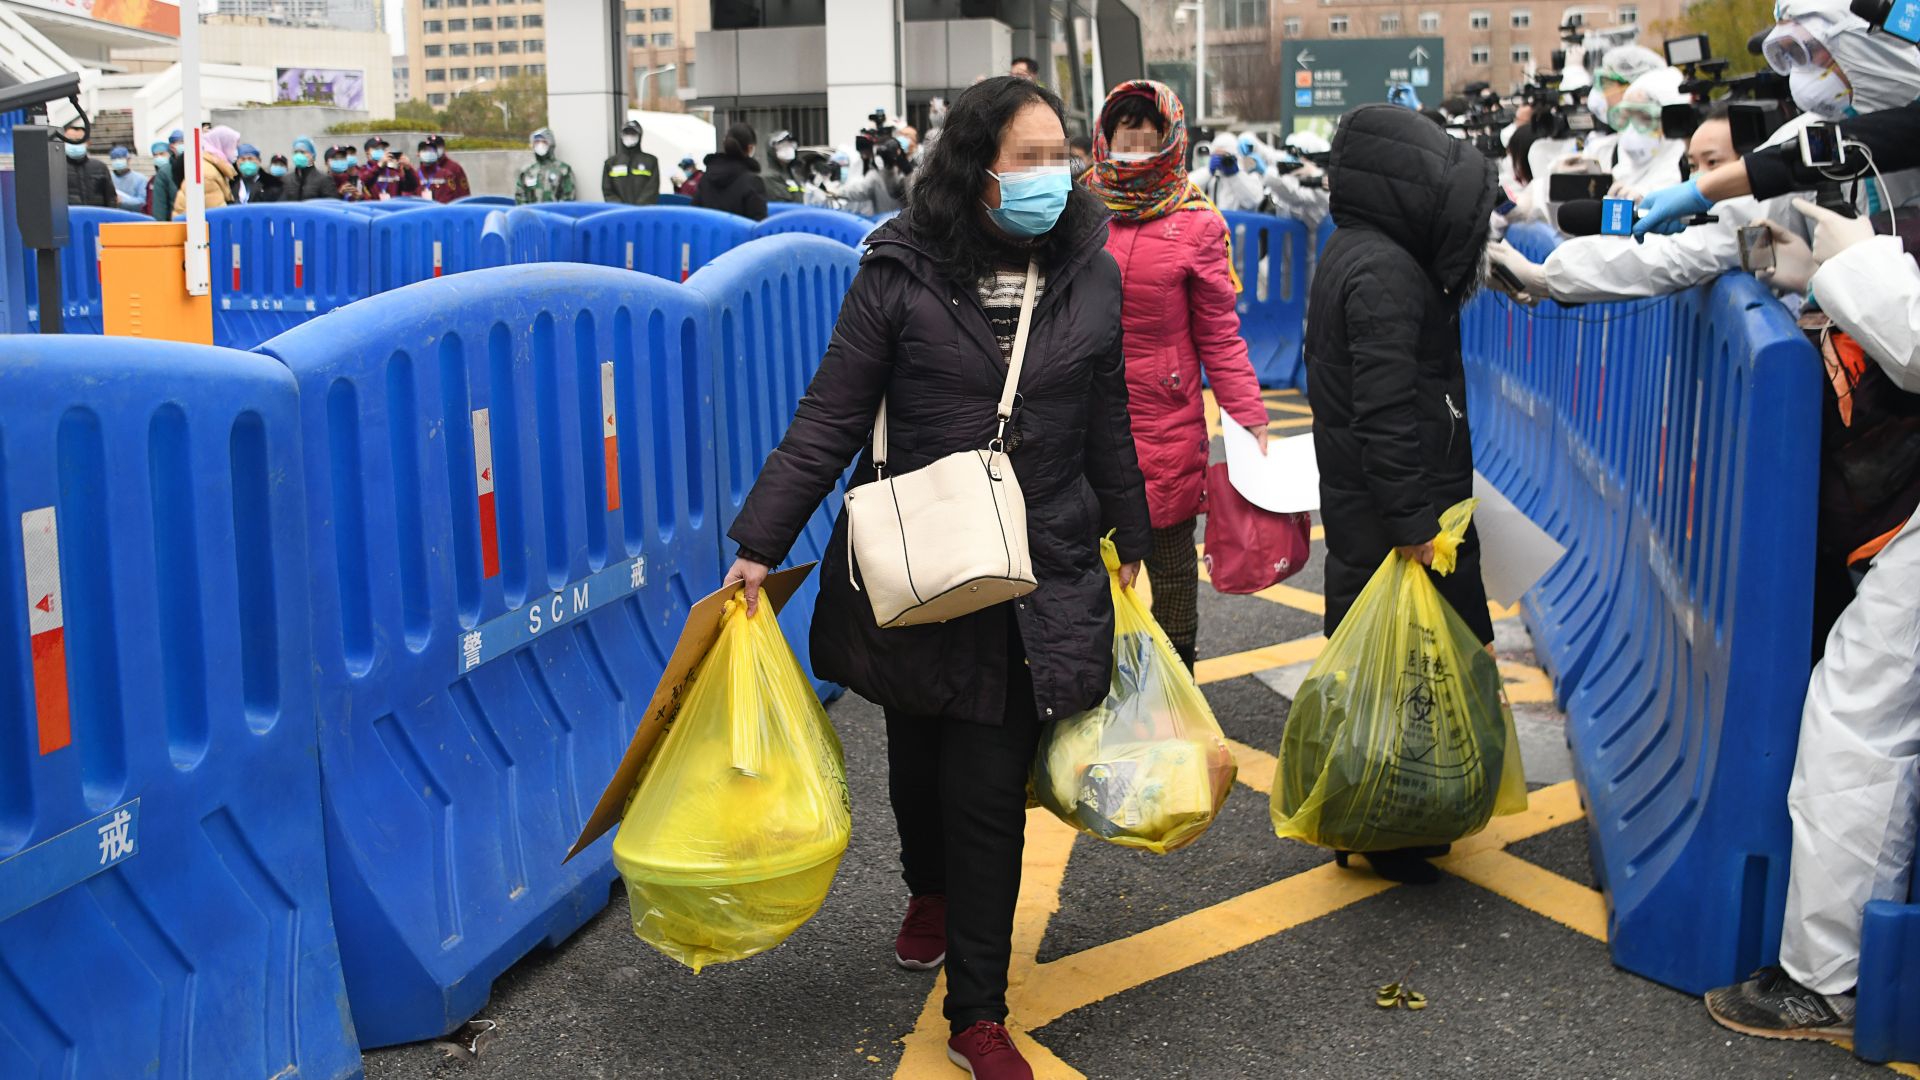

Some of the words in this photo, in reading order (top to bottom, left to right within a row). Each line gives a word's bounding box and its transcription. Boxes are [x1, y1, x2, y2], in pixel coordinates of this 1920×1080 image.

[463, 630, 482, 672] 警
[529, 583, 589, 634] SCM
[630, 556, 645, 588] 戒
[98, 809, 134, 865] 戒
